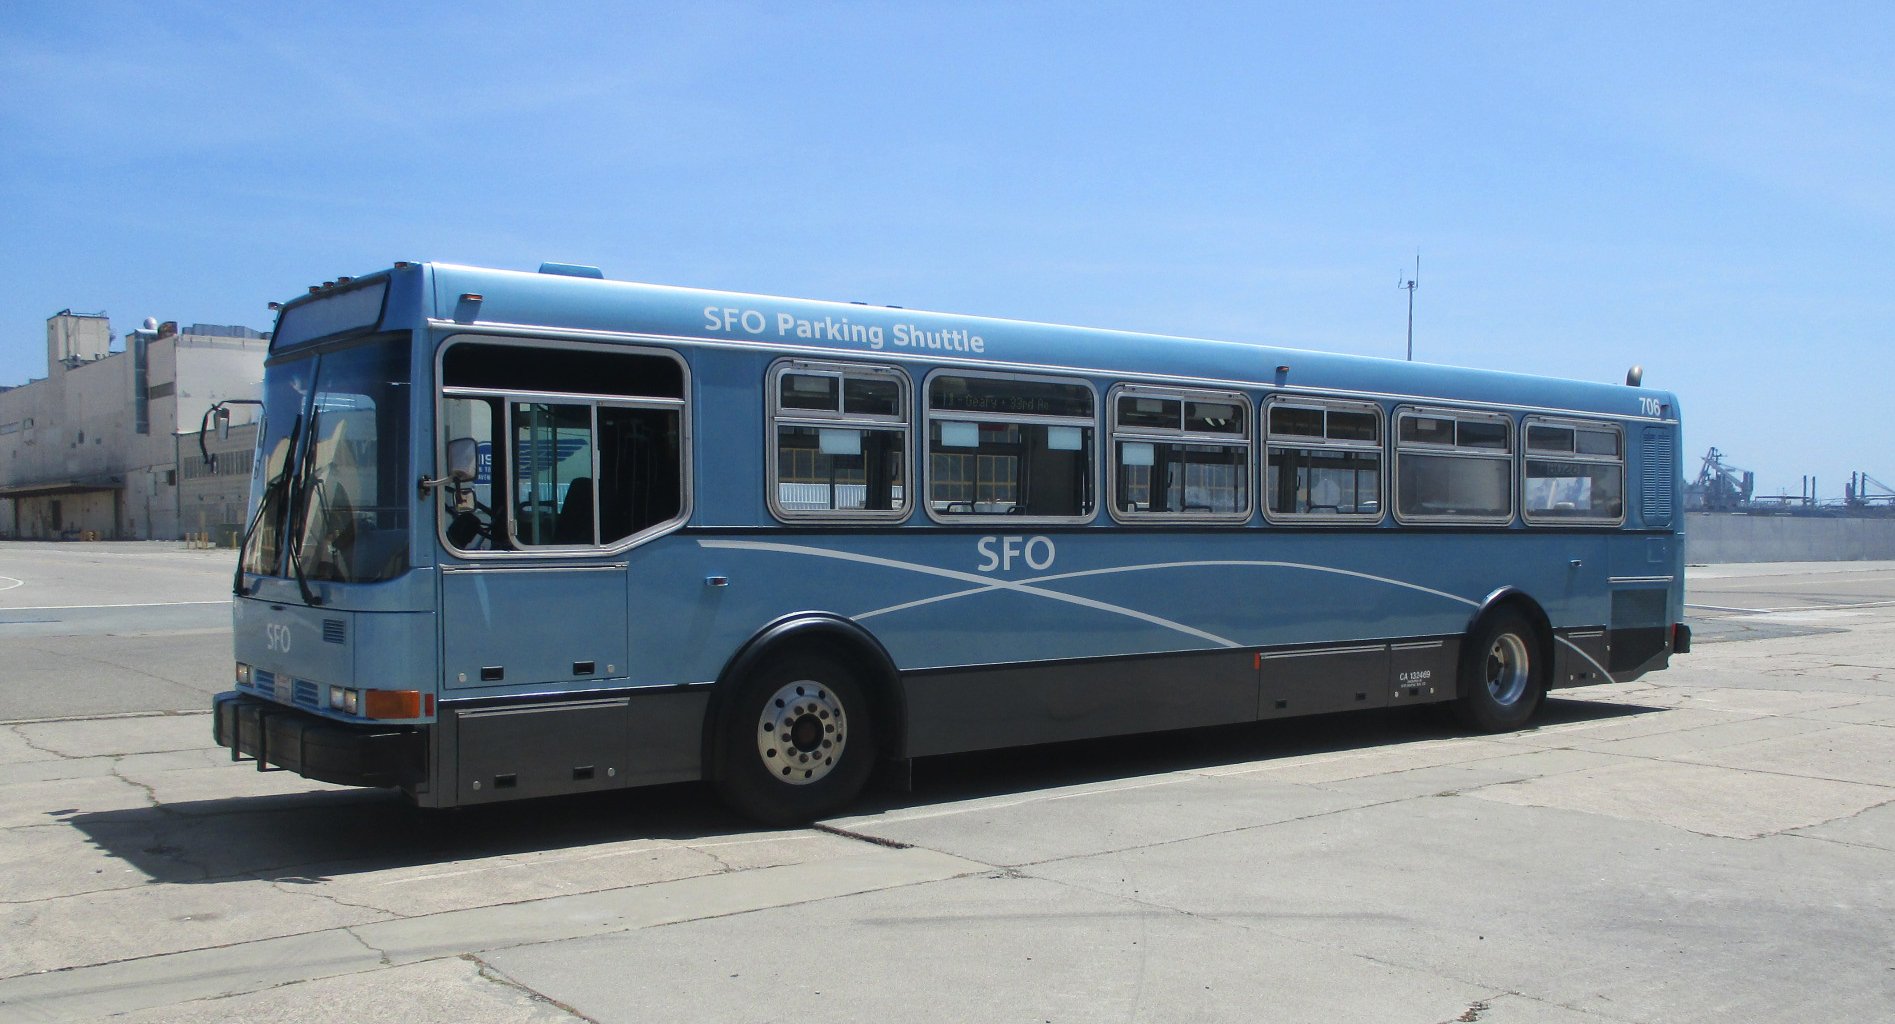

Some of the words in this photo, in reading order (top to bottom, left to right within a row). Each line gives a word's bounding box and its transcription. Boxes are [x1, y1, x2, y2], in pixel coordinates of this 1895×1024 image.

[703, 306, 766, 334] SFO
[777, 312, 884, 350] Parking
[892, 324, 985, 353] Shuttle
[1639, 397, 1661, 417] 706
[977, 535, 1056, 572] SFO
[267, 622, 291, 653] SFO
[1400, 672, 1408, 680] CA
